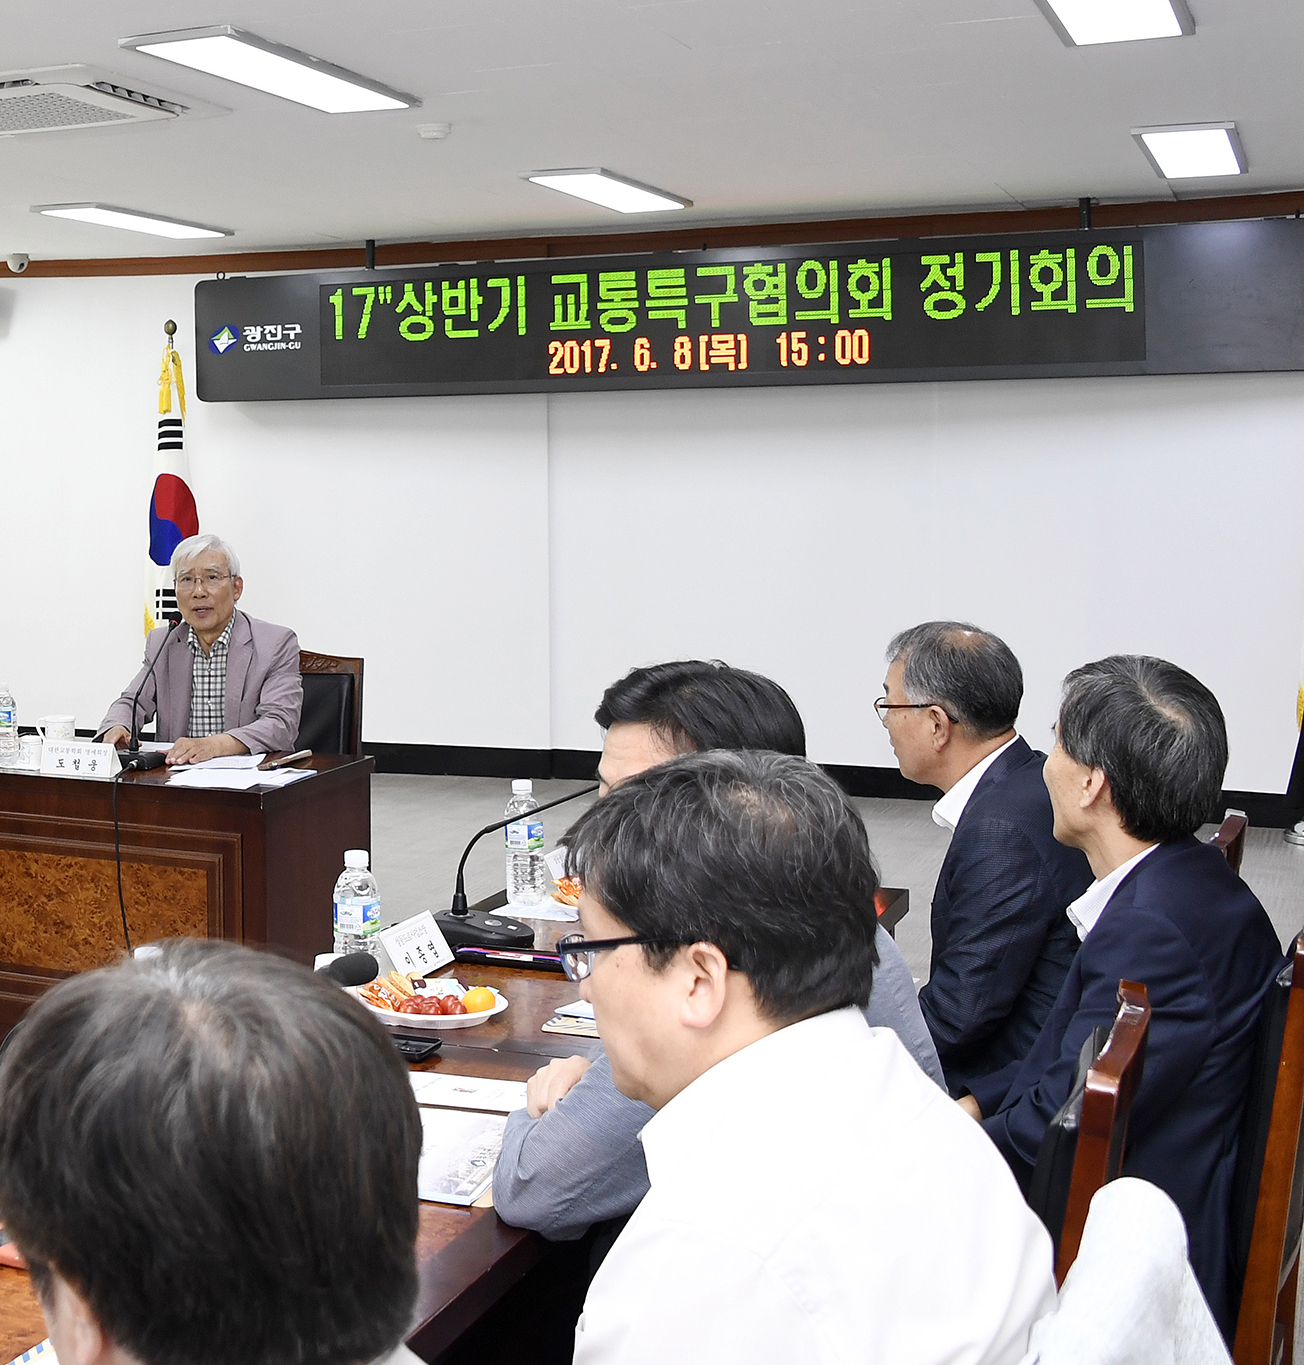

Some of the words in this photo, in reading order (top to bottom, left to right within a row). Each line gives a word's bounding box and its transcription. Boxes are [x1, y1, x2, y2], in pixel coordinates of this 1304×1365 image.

[549, 257, 893, 333] 교통특구협의회
[919, 244, 1135, 320] 정기회의
[242, 323, 303, 343] 광진구
[243, 341, 301, 352] GWANGJIN-GU
[548, 338, 618, 375] 2017.
[633, 336, 658, 372] 6.
